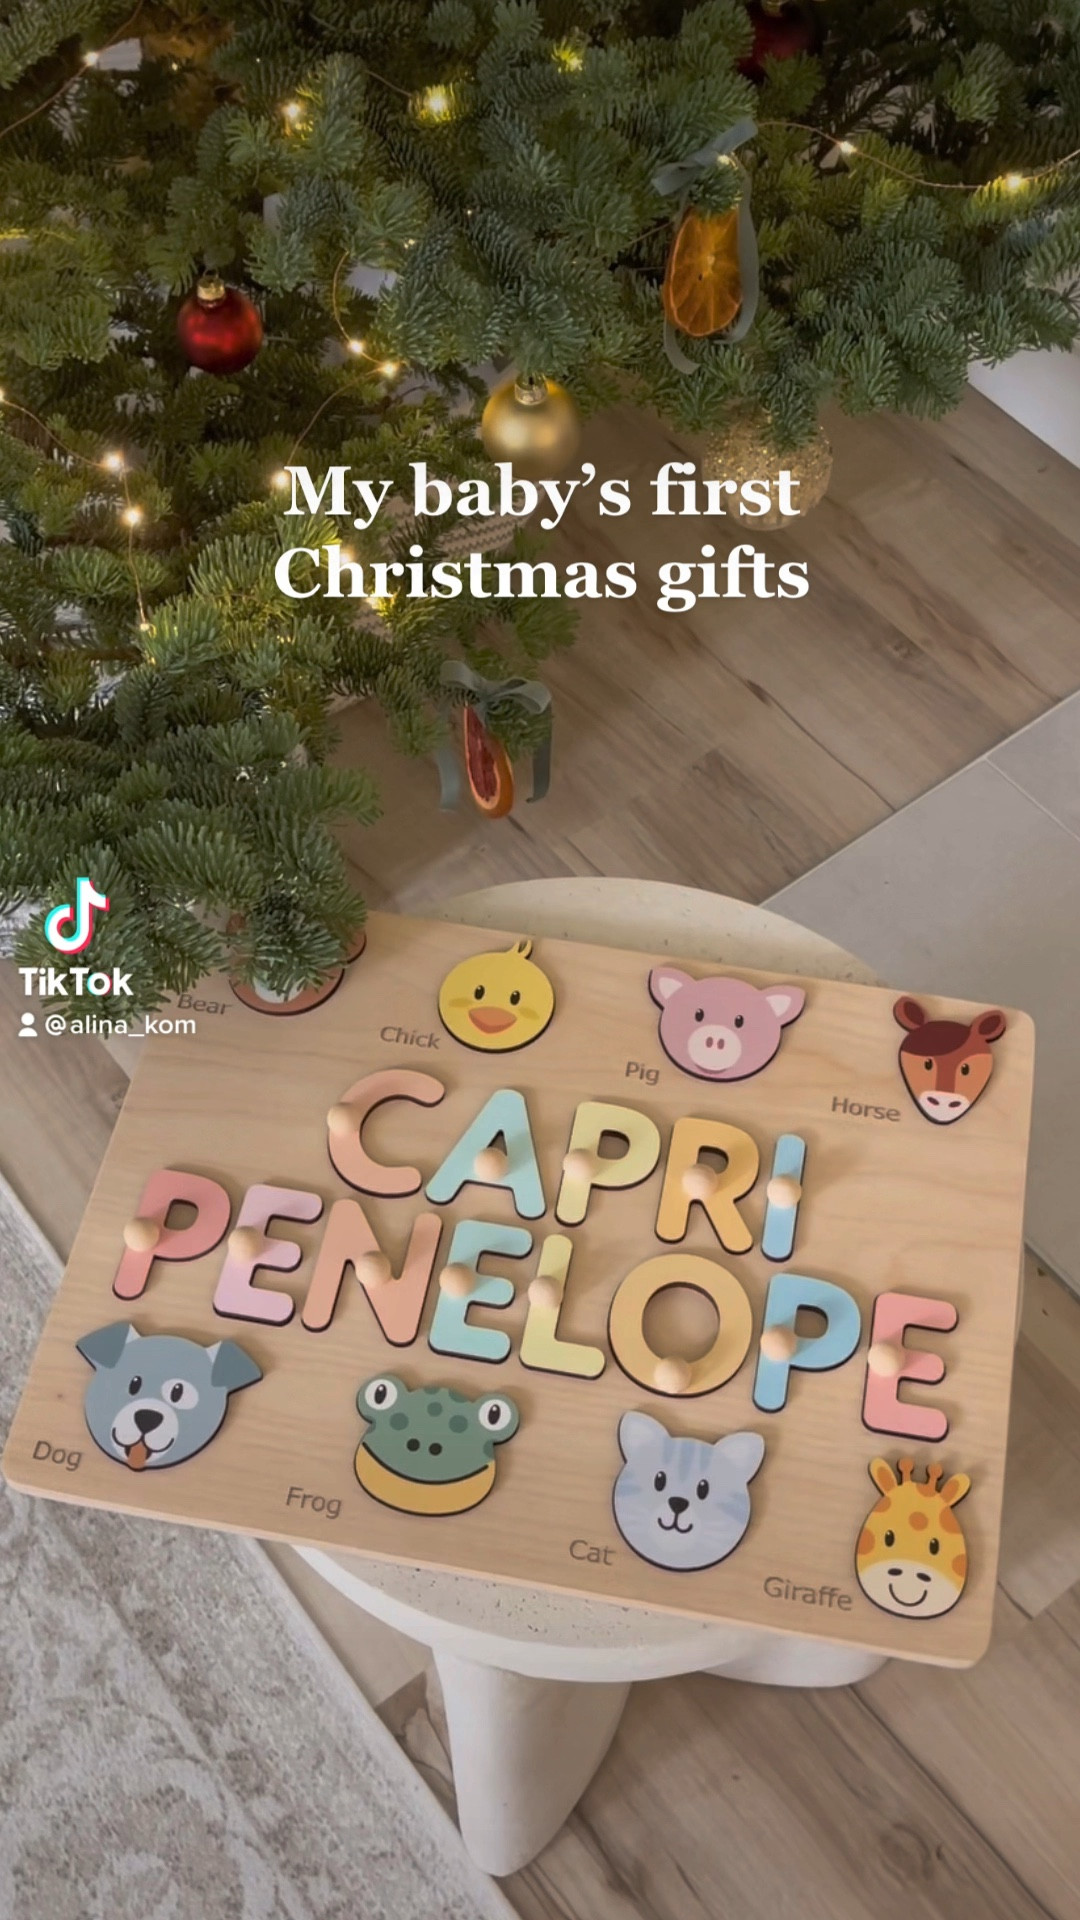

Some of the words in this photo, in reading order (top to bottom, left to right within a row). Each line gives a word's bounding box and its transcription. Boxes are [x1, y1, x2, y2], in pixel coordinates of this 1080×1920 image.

[177, 993, 233, 1016] Bear
[379, 1025, 441, 1051] Chick
[624, 1061, 661, 1086] Pig
[831, 1096, 901, 1122] Horse
[327, 1068, 806, 1262] CAPRI
[112, 1168, 959, 1443] PENELOPE
[32, 1440, 83, 1471] Dog
[285, 1486, 342, 1520] Frog
[568, 1539, 617, 1567] Cat
[763, 1576, 853, 1611] Giraffe
